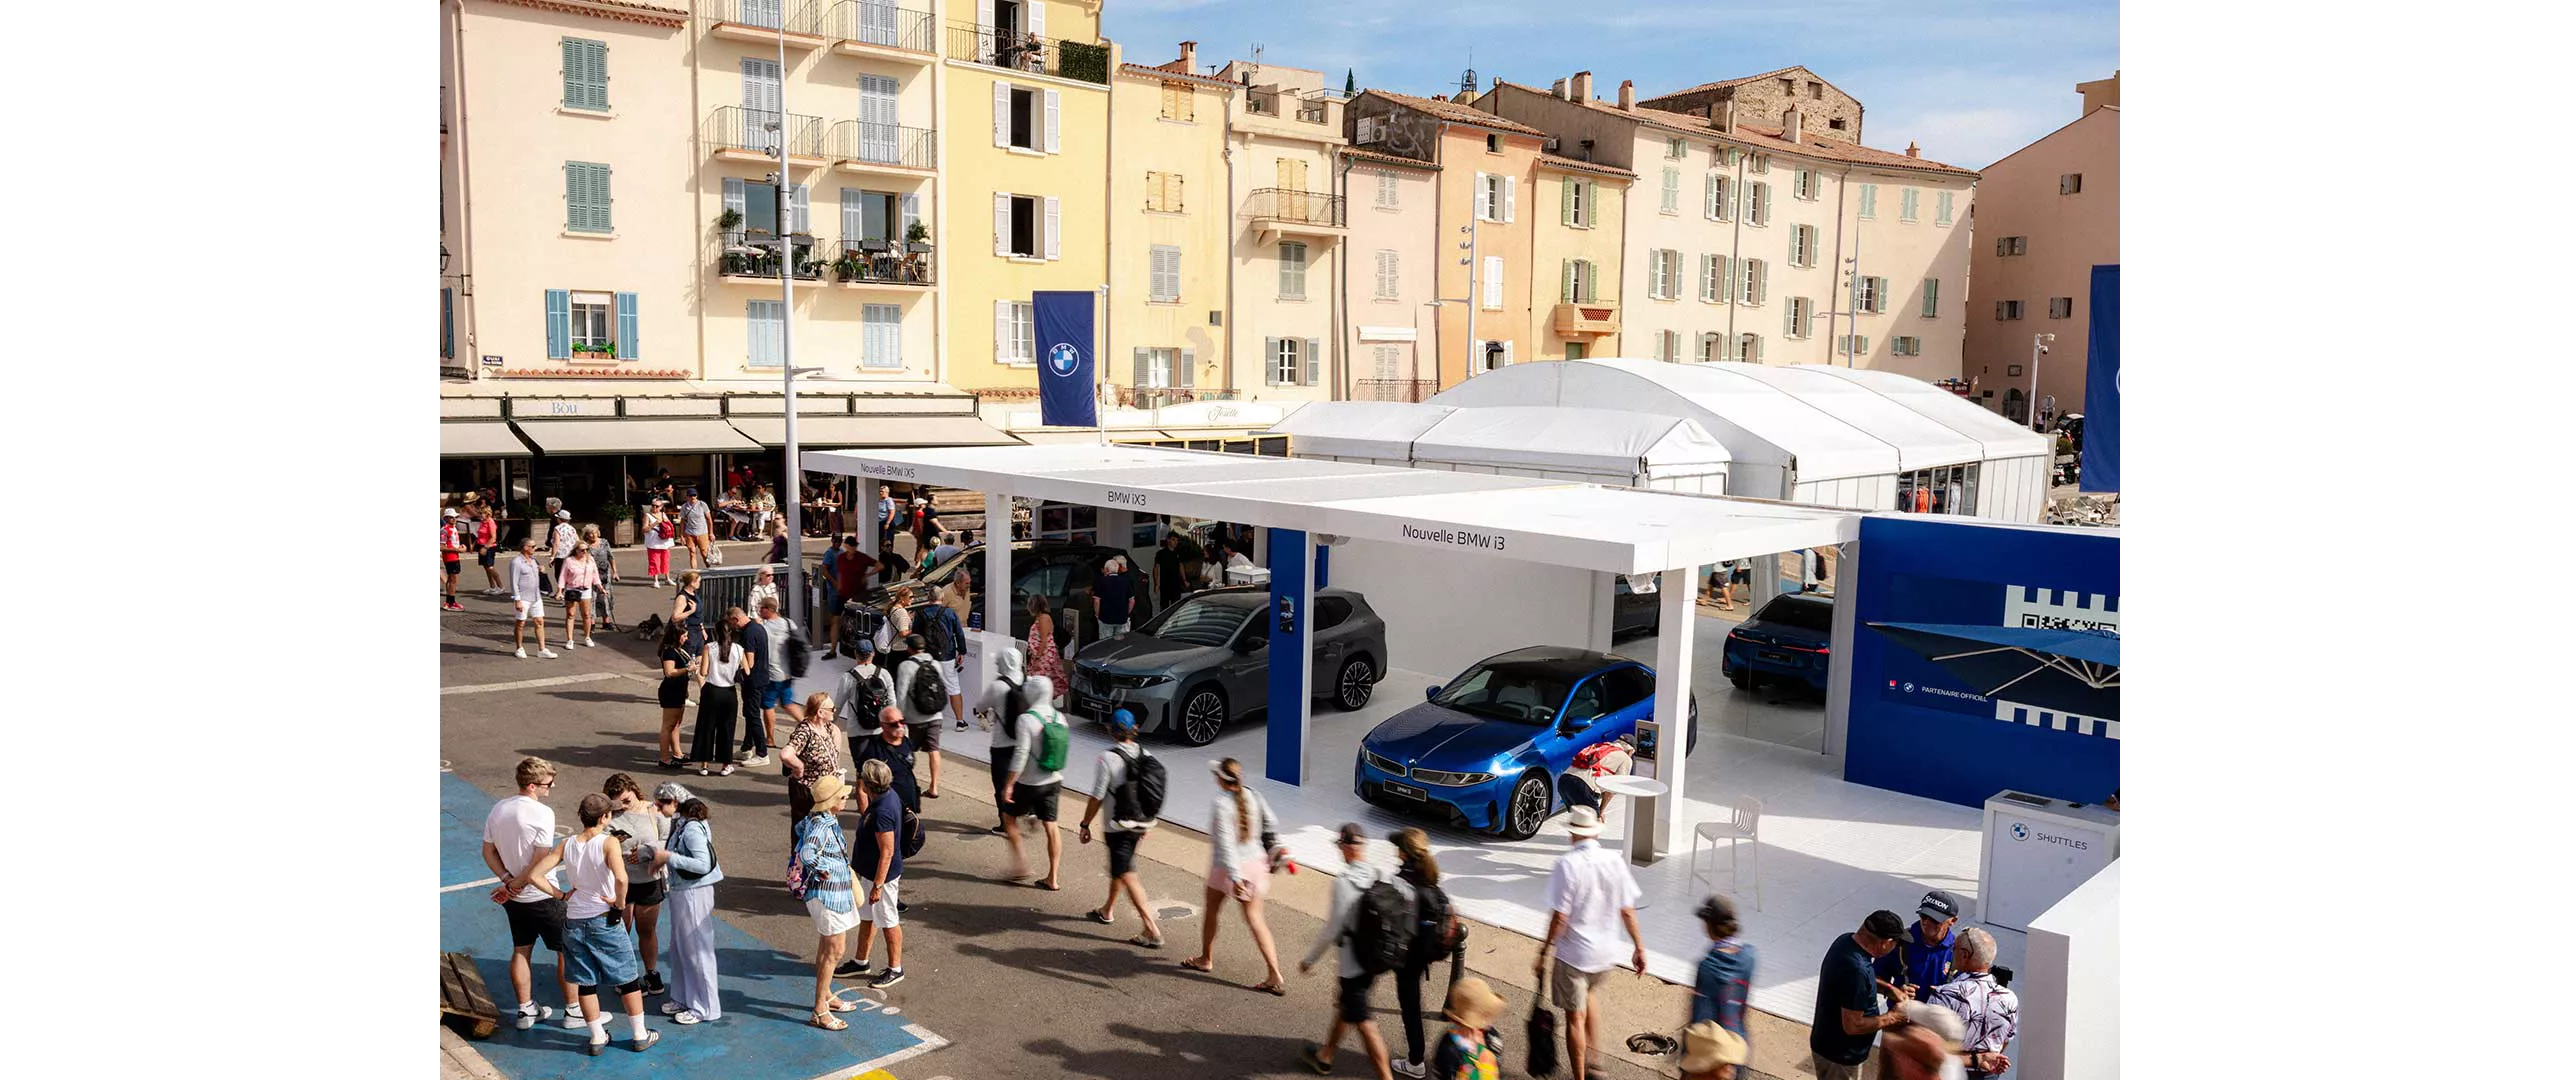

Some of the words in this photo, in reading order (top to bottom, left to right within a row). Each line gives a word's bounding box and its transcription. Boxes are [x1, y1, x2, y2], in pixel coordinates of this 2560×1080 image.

[861, 463, 886, 475] Nouvelle
[887, 465, 904, 477] BMW
[905, 467, 915, 479] iX5
[1107, 490, 1130, 504] BMW
[1131, 493, 1146, 506] iX3
[1402, 524, 1454, 544] Nouvelle
[1457, 531, 1491, 548] BMW
[1494, 536, 1505, 551] i3
[1921, 686, 1959, 698] PARTENAIRE
[2036, 832, 2088, 851] SHUTTLES
